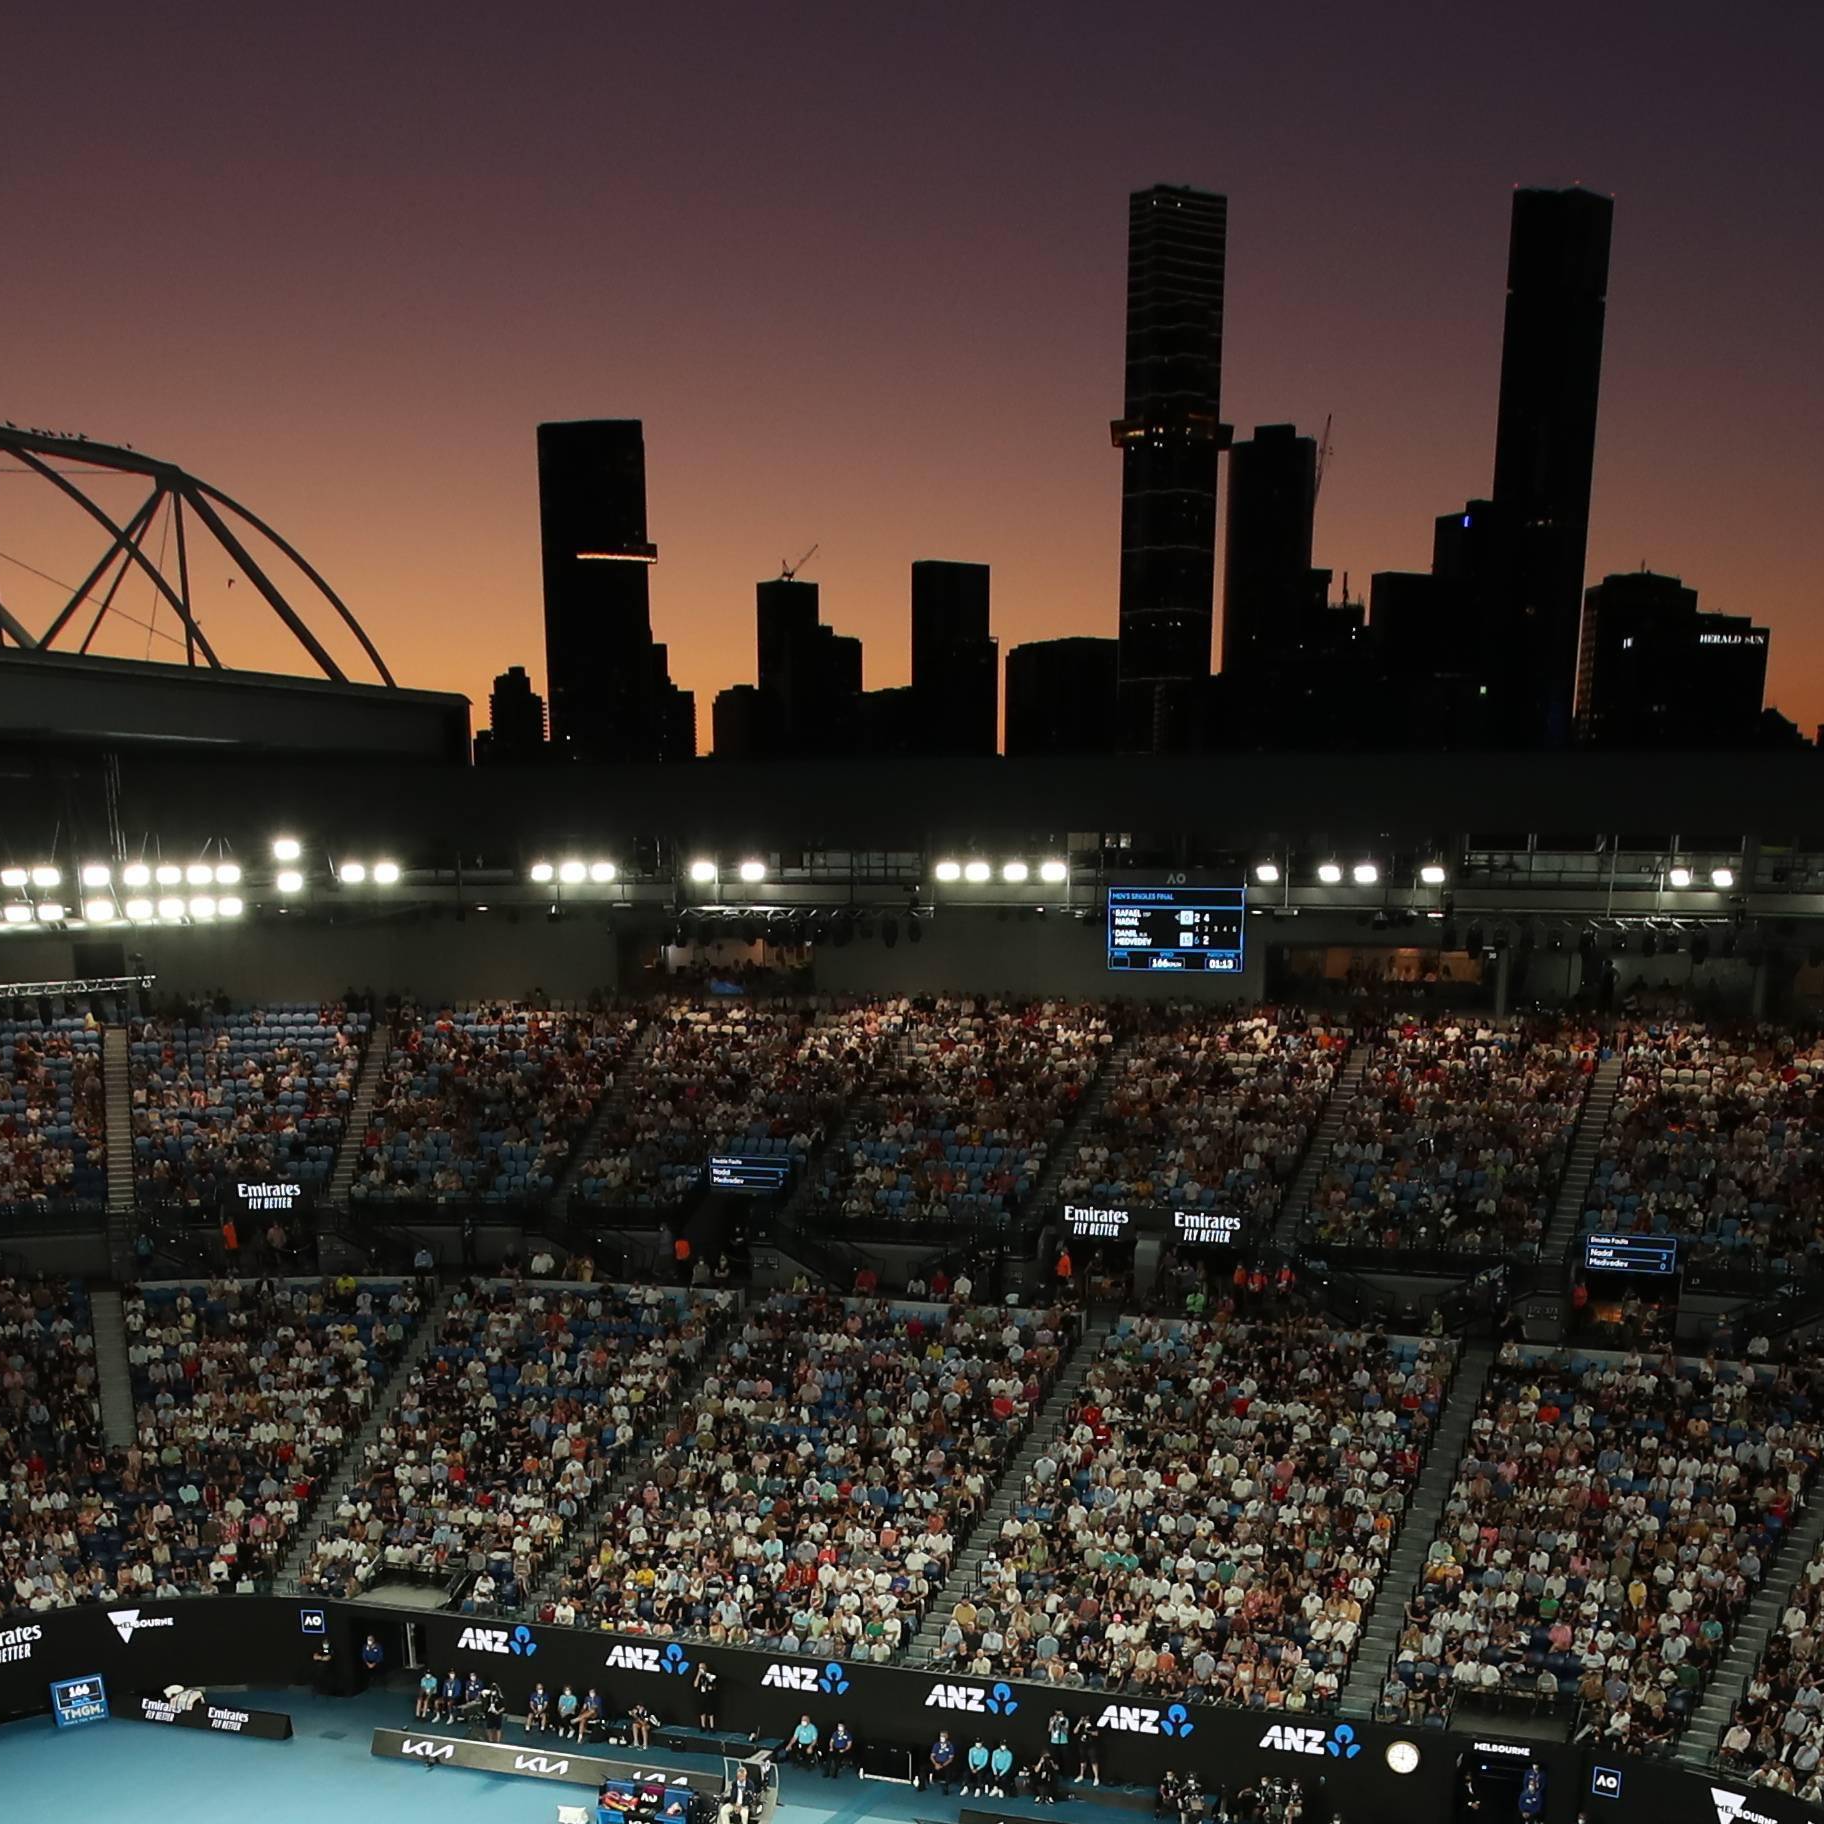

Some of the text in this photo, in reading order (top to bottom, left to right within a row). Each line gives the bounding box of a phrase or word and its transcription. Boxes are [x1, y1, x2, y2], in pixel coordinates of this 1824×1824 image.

[1194, 913, 1200, 922] 2
[1203, 913, 1210, 922] 4
[1202, 935, 1210, 945] 2
[237, 1182, 302, 1198] Emirates
[1064, 1205, 1129, 1223] Emirates
[1175, 1211, 1241, 1230] Emirates
[1073, 1221, 1088, 1235] FLY
[1183, 1227, 1198, 1241] FLY
[457, 1627, 510, 1655] ANZ
[605, 1644, 661, 1674] ANZ
[761, 1664, 819, 1692] ANZ
[68, 1683, 90, 1698] 166
[925, 1683, 985, 1712] ANZ
[208, 1706, 249, 1723] Emirates
[1097, 1704, 1160, 1735] ANZ
[1259, 1724, 1326, 1756] ANZ
[1474, 1742, 1530, 1757] MELBOURNE
